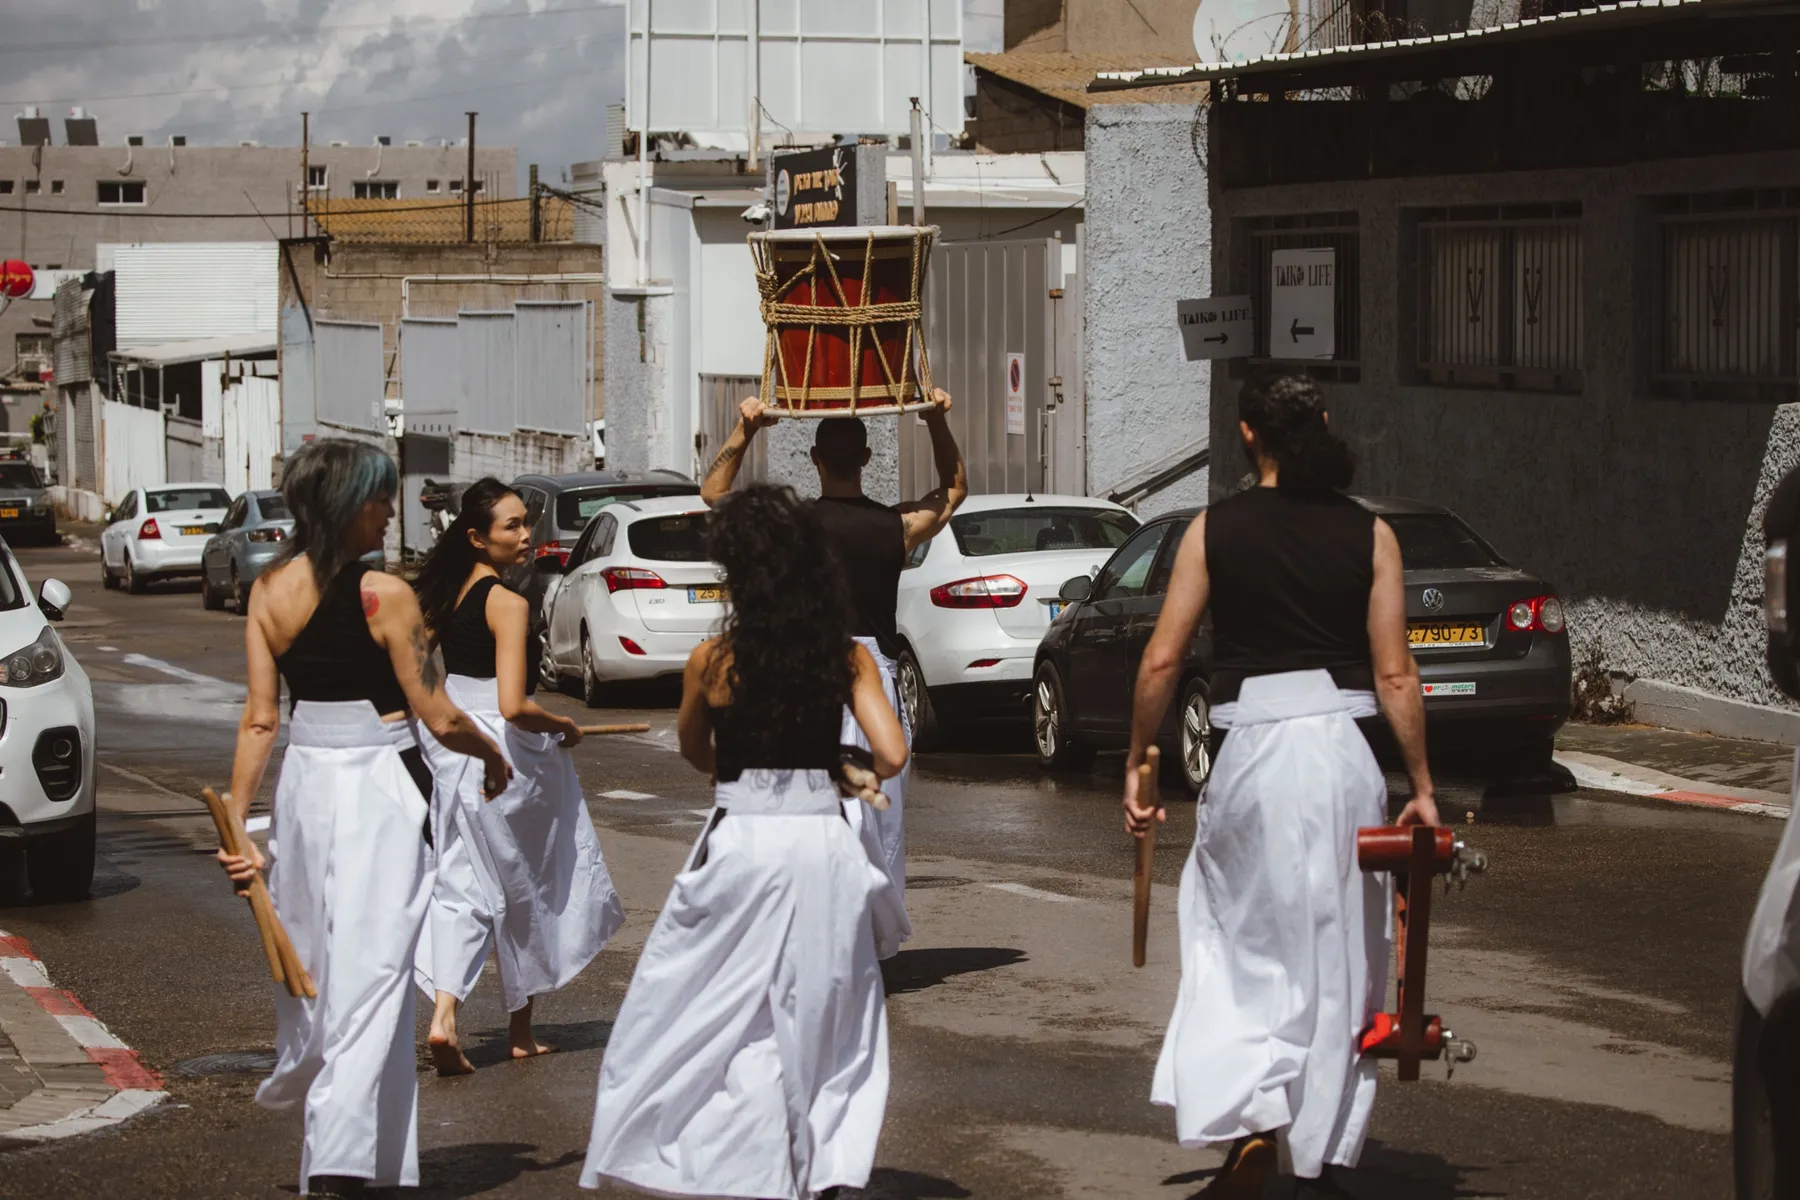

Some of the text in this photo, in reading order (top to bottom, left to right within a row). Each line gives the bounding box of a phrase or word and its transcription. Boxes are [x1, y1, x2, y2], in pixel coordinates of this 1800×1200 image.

[1275, 264, 1333, 287] TAIKO LIFE
[1181, 308, 1250, 325] TAIKO LIFE
